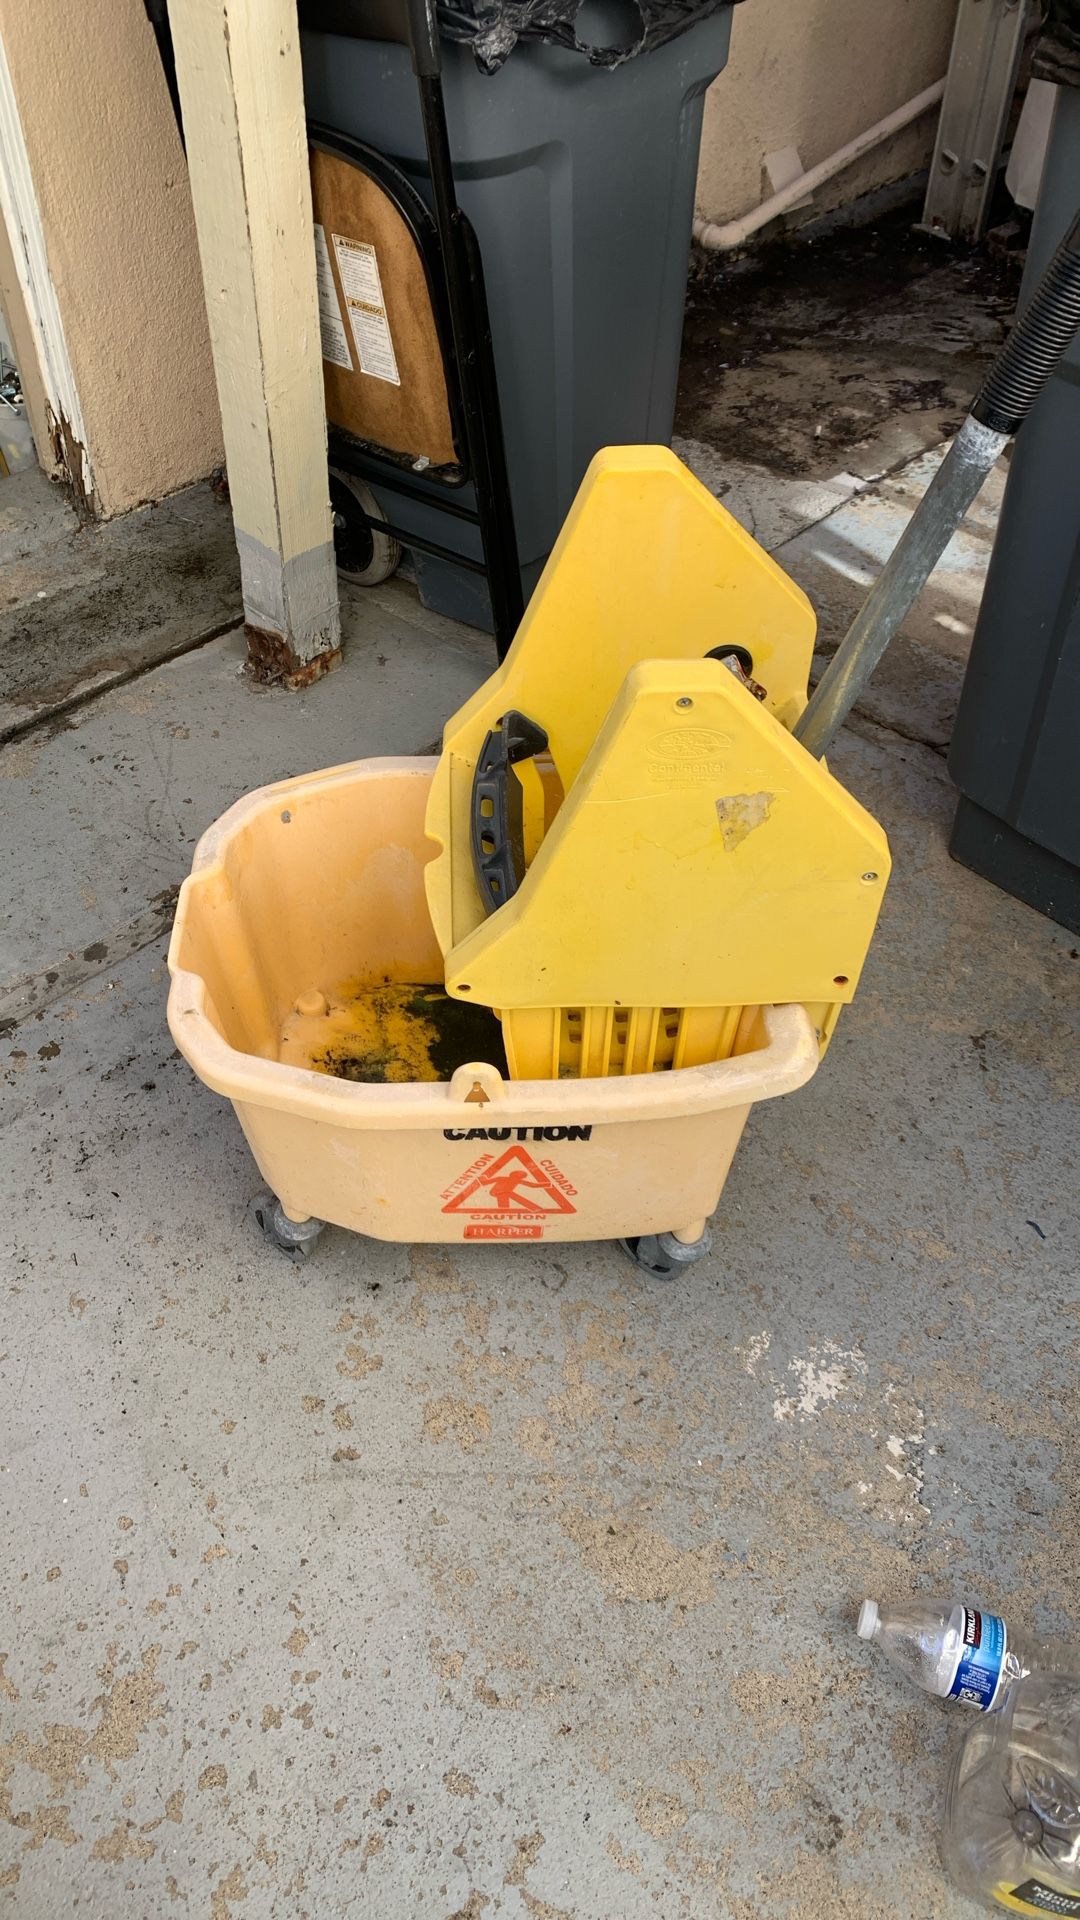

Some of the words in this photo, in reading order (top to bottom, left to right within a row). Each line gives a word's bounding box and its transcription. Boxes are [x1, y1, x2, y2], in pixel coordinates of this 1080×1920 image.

[345, 241, 372, 254] WARNING
[443, 1125, 593, 1141] CAUTION
[440, 1153, 495, 1200] ATTENTION
[540, 1159, 578, 1197] CUIDADO
[470, 1213, 547, 1221] CAUTION
[473, 1226, 534, 1236] HARPER
